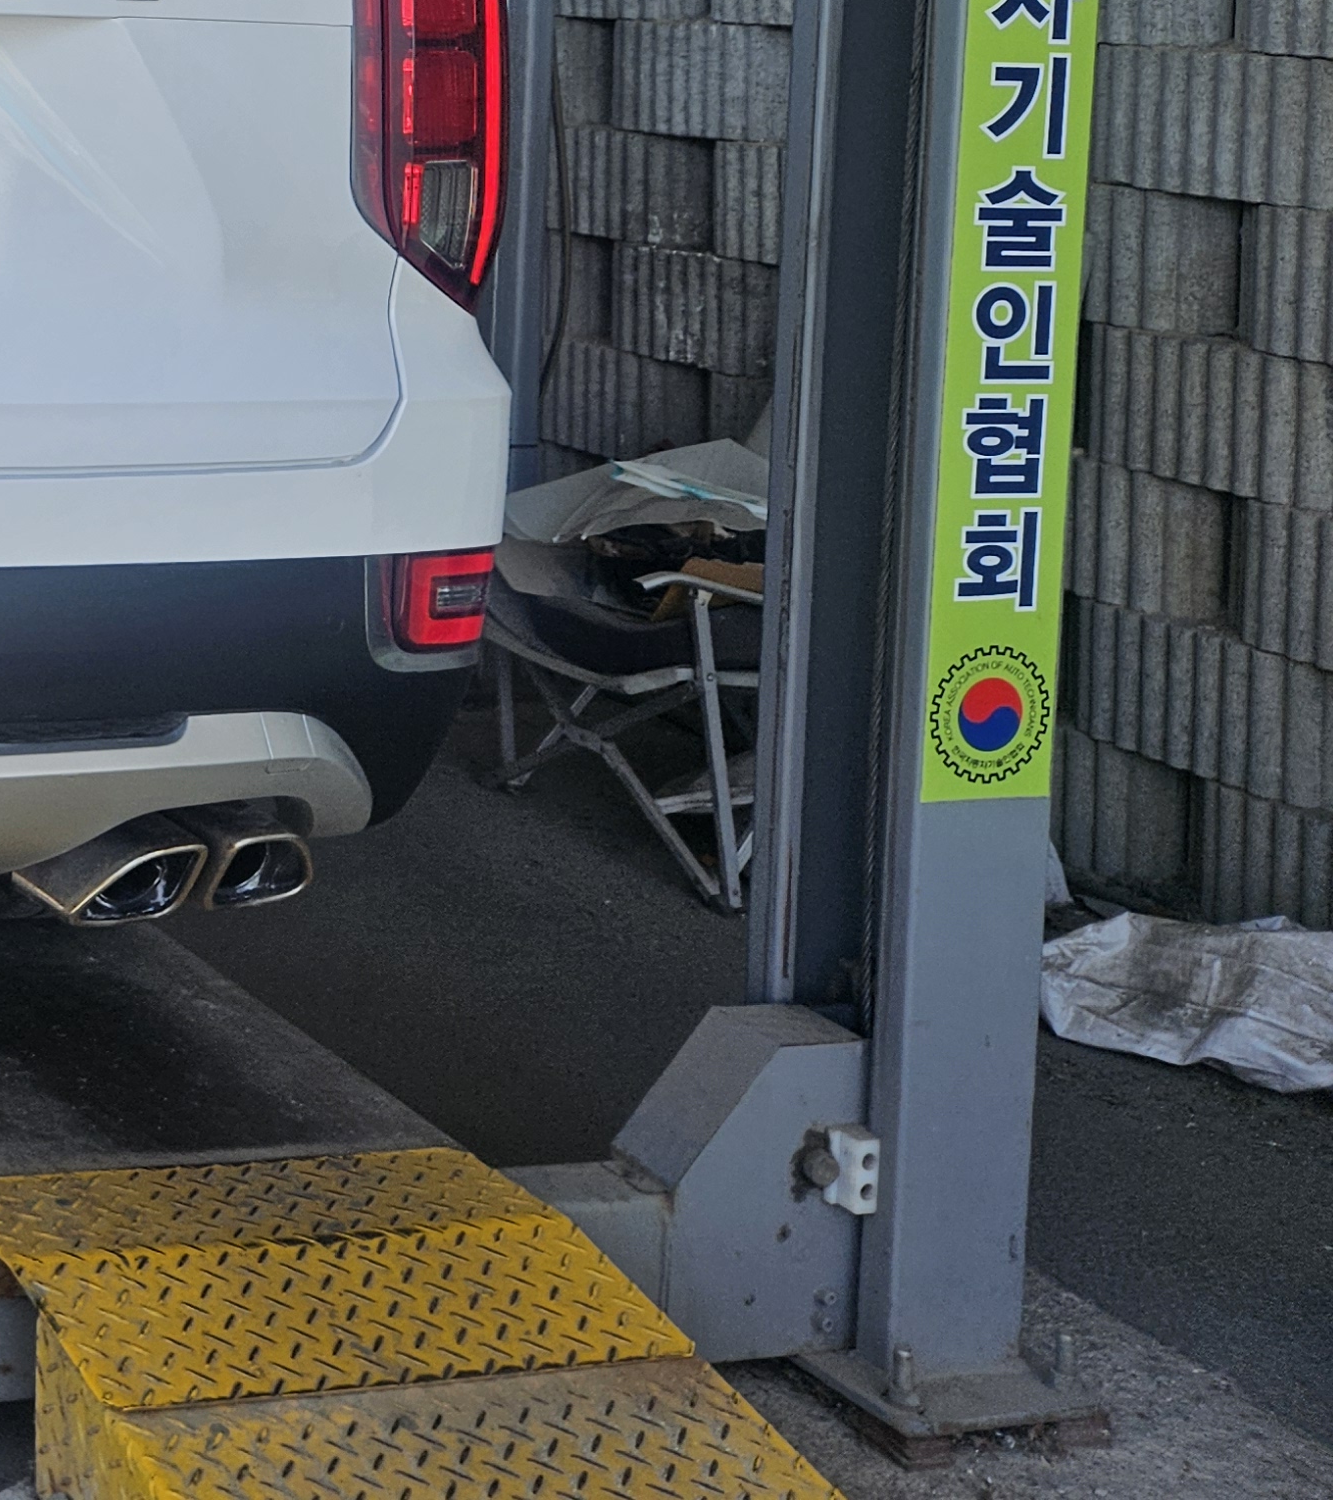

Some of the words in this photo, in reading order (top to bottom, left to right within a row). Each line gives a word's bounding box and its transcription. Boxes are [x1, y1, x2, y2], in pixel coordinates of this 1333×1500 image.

[946, 662, 989, 707] ASSOCIATION
[991, 661, 1003, 669] OF
[1004, 665, 1024, 681] AUTO
